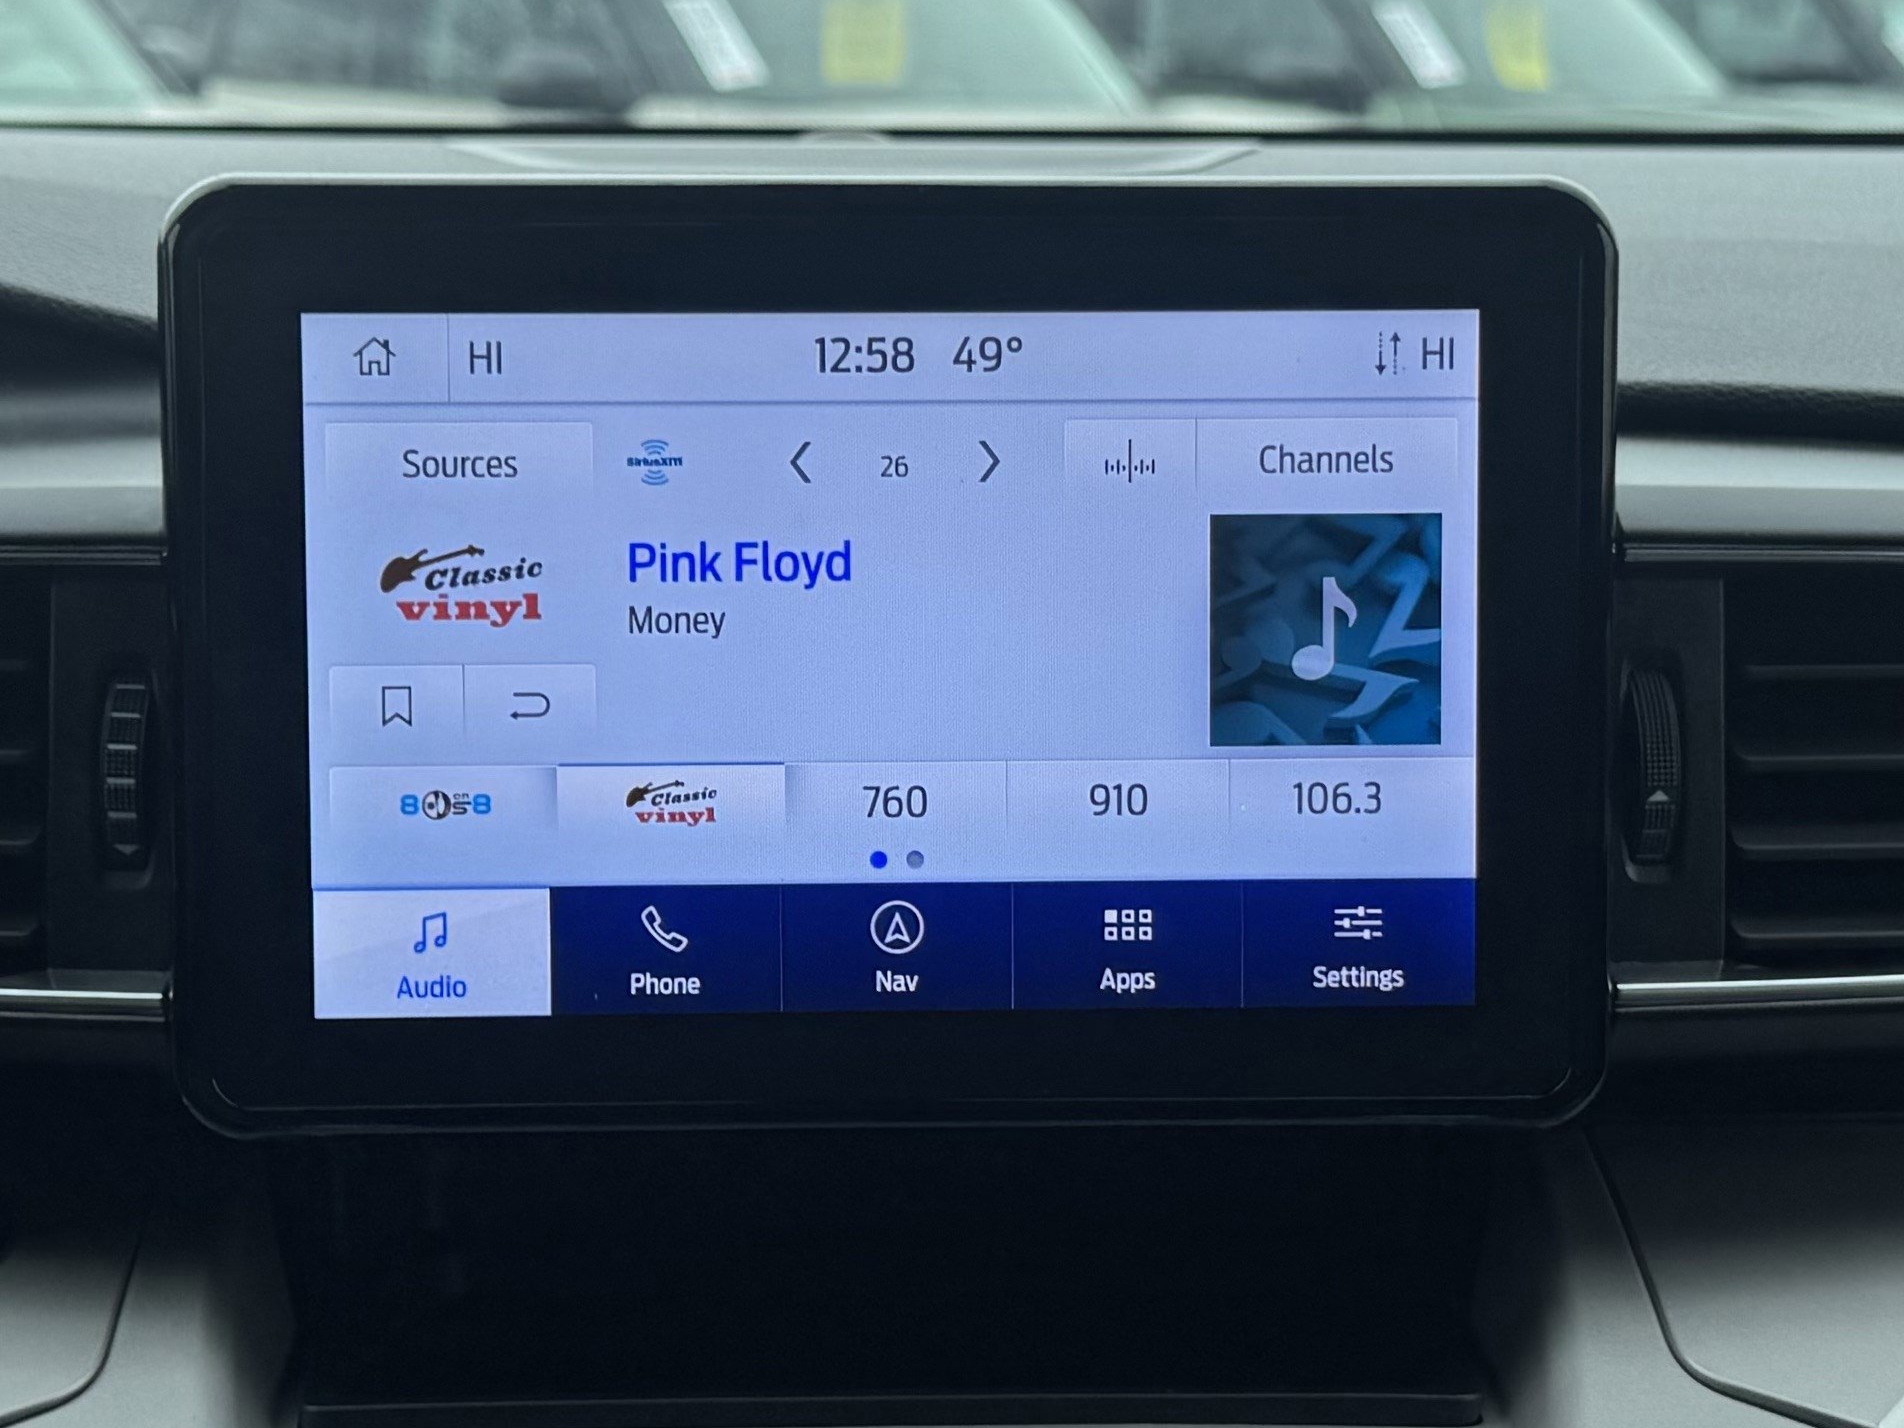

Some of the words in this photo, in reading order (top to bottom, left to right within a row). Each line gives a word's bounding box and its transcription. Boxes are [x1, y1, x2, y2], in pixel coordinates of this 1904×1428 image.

[469, 340, 502, 375] HI
[814, 336, 915, 374] 12:58
[952, 336, 1023, 373] 49°
[1422, 336, 1455, 370] HI
[402, 449, 518, 479] Sources
[880, 455, 909, 478] 26
[1259, 443, 1394, 474] Channels
[424, 557, 543, 591] Classic
[629, 540, 723, 583] Pink
[735, 539, 851, 590] Floyd
[396, 593, 542, 628] vinyl
[628, 605, 726, 639] Money
[651, 786, 717, 807] Classic
[862, 785, 928, 819] 760
[1089, 783, 1148, 817] 910
[1292, 781, 1382, 815] 106.3
[635, 806, 716, 827] vinyl
[396, 974, 467, 999] Audio
[630, 971, 701, 995] Phone
[875, 970, 919, 993] Nav
[1099, 967, 1156, 994] Apps
[1312, 965, 1405, 992] Settings
